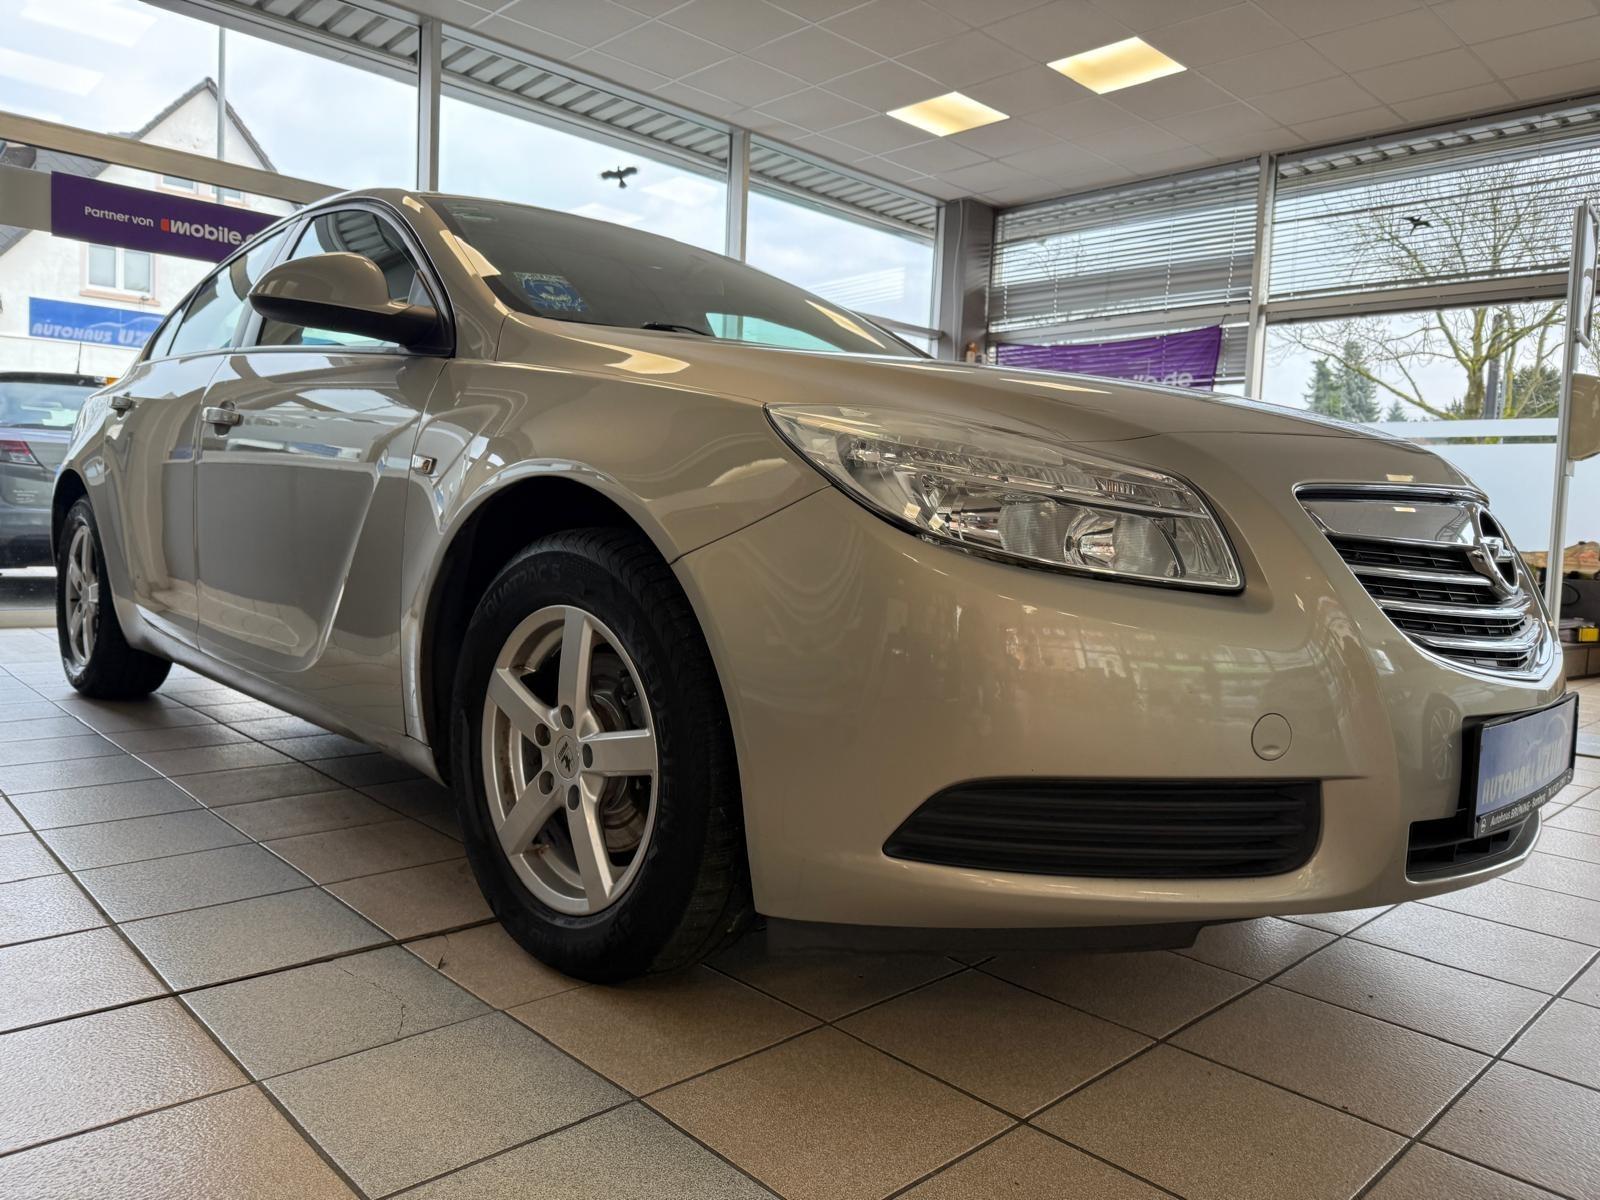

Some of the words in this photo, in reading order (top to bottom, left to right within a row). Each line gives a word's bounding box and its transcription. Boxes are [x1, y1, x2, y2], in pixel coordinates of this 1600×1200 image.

[84, 205, 130, 223] Partner
[131, 214, 154, 227] von
[31, 322, 113, 343] AUTOHAUS
[118, 328, 150, 346] UZ
